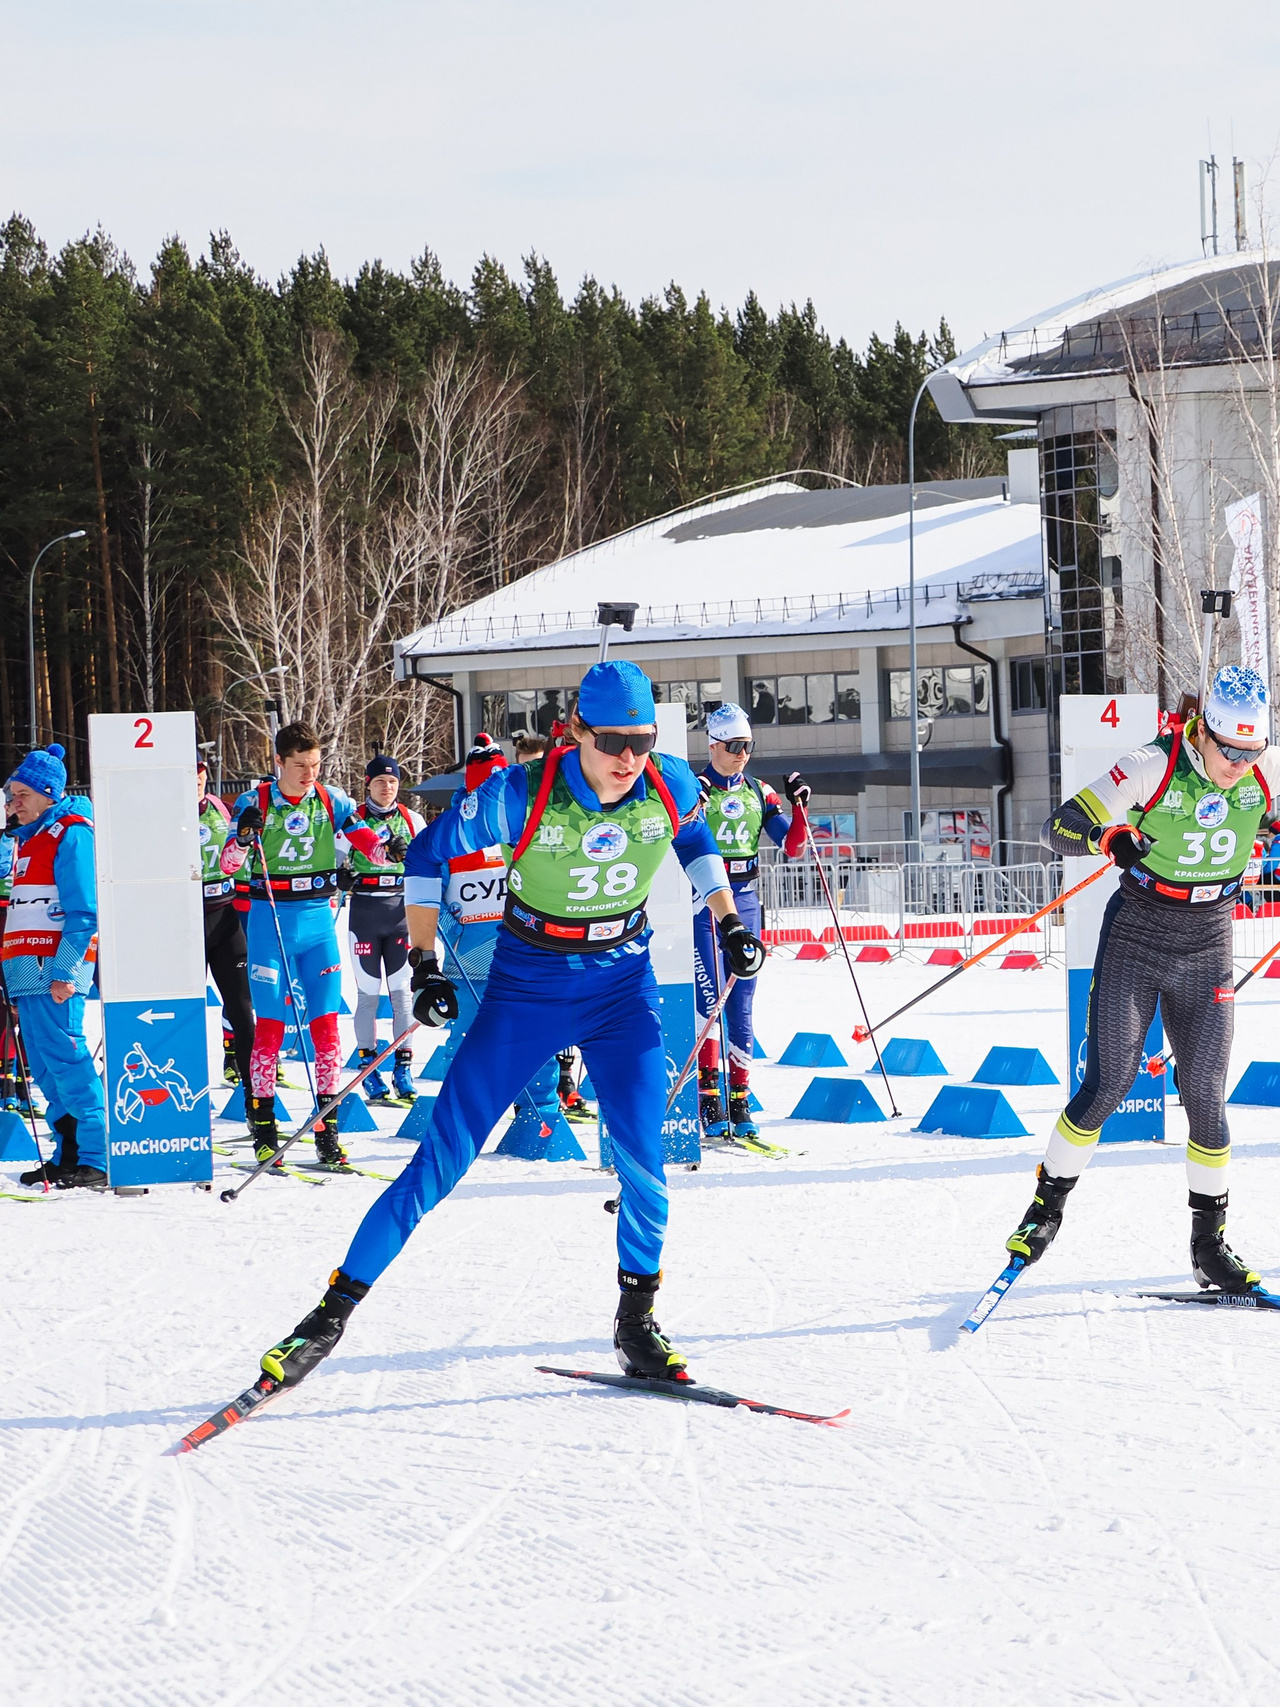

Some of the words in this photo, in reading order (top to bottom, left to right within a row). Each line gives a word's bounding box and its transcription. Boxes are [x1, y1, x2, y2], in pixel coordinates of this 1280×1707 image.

[1100, 700, 1120, 728] 4
[133, 718, 153, 749] 2
[716, 820, 750, 845] 44
[278, 836, 315, 862] 43
[1177, 828, 1238, 865] 39
[567, 862, 640, 901] 38
[1174, 868, 1232, 879] КРАСНОЯРСК
[565, 898, 630, 912] КРАСНОЯРСК
[26, 936, 54, 946] край
[1111, 1098, 1163, 1114] ОЯРСК
[110, 1138, 210, 1157] КРАСНОЯРСК
[622, 1275, 638, 1286] 188
[1217, 1295, 1257, 1308] SALOMON
